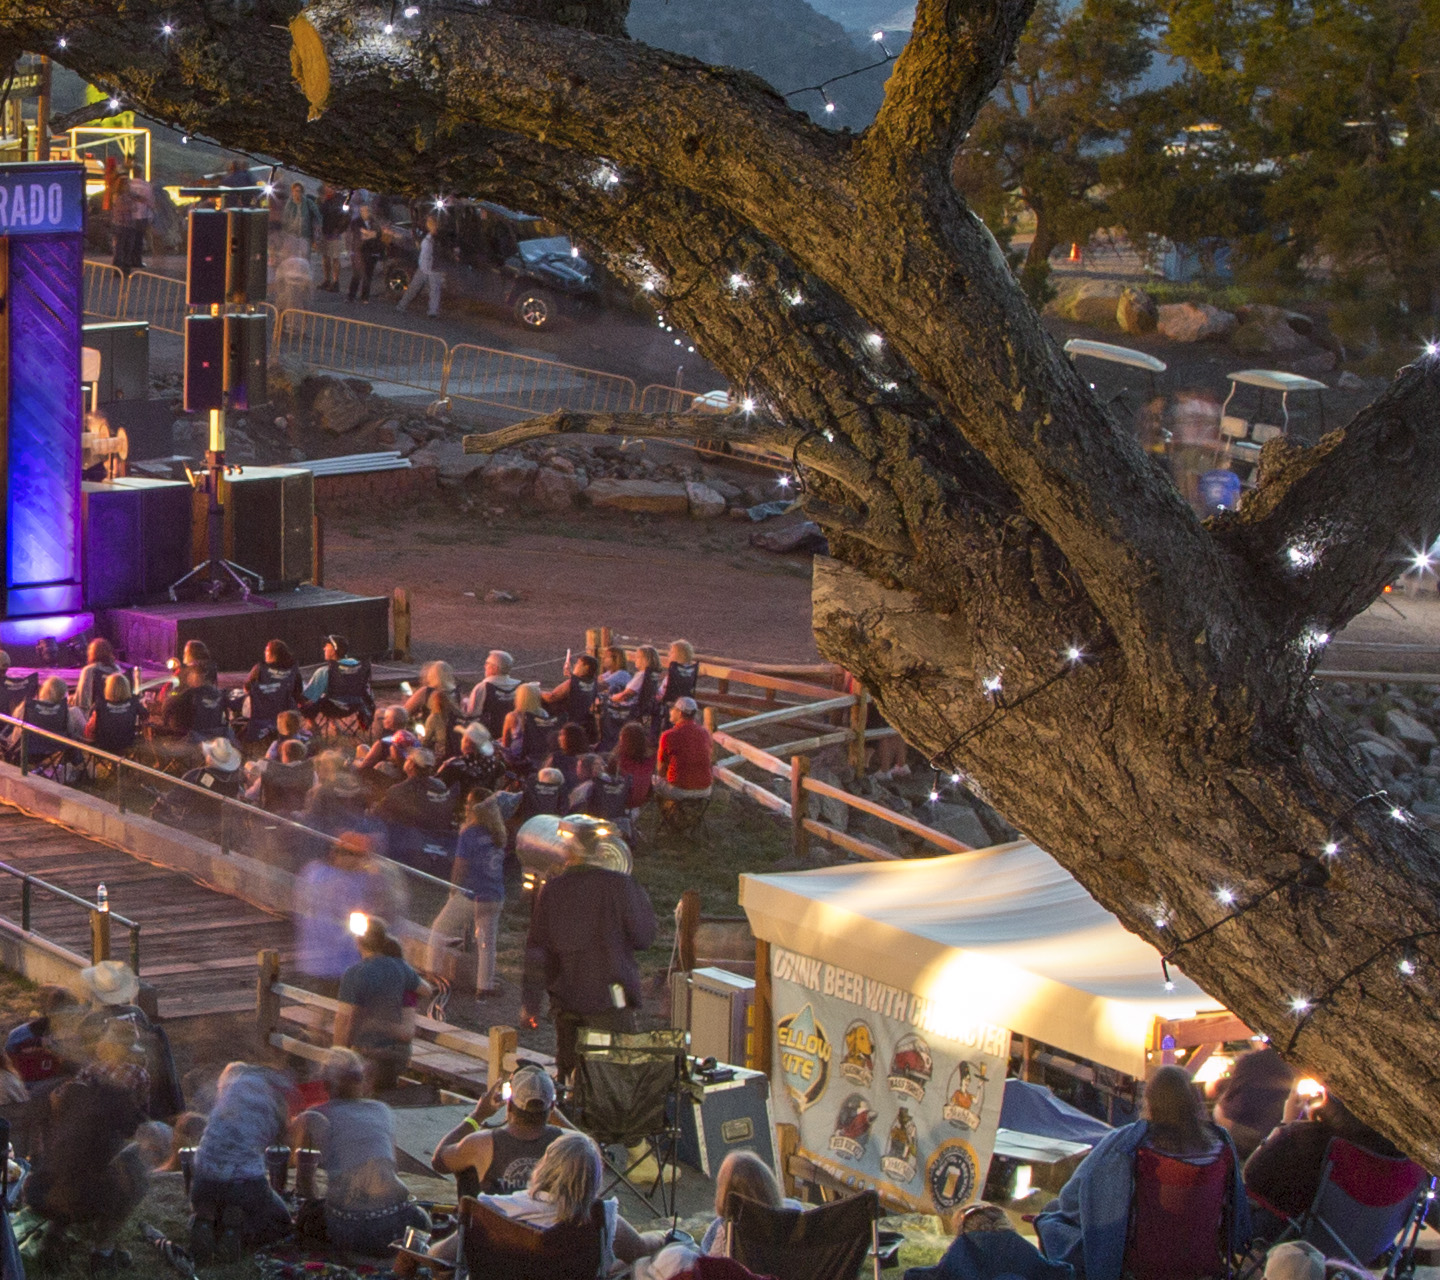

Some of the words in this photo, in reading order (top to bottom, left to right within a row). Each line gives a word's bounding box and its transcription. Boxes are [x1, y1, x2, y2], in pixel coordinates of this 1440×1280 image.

[823, 964, 866, 1006] BEER
[865, 978, 910, 1022] WITH
[778, 1027, 832, 1062] ELLOW
